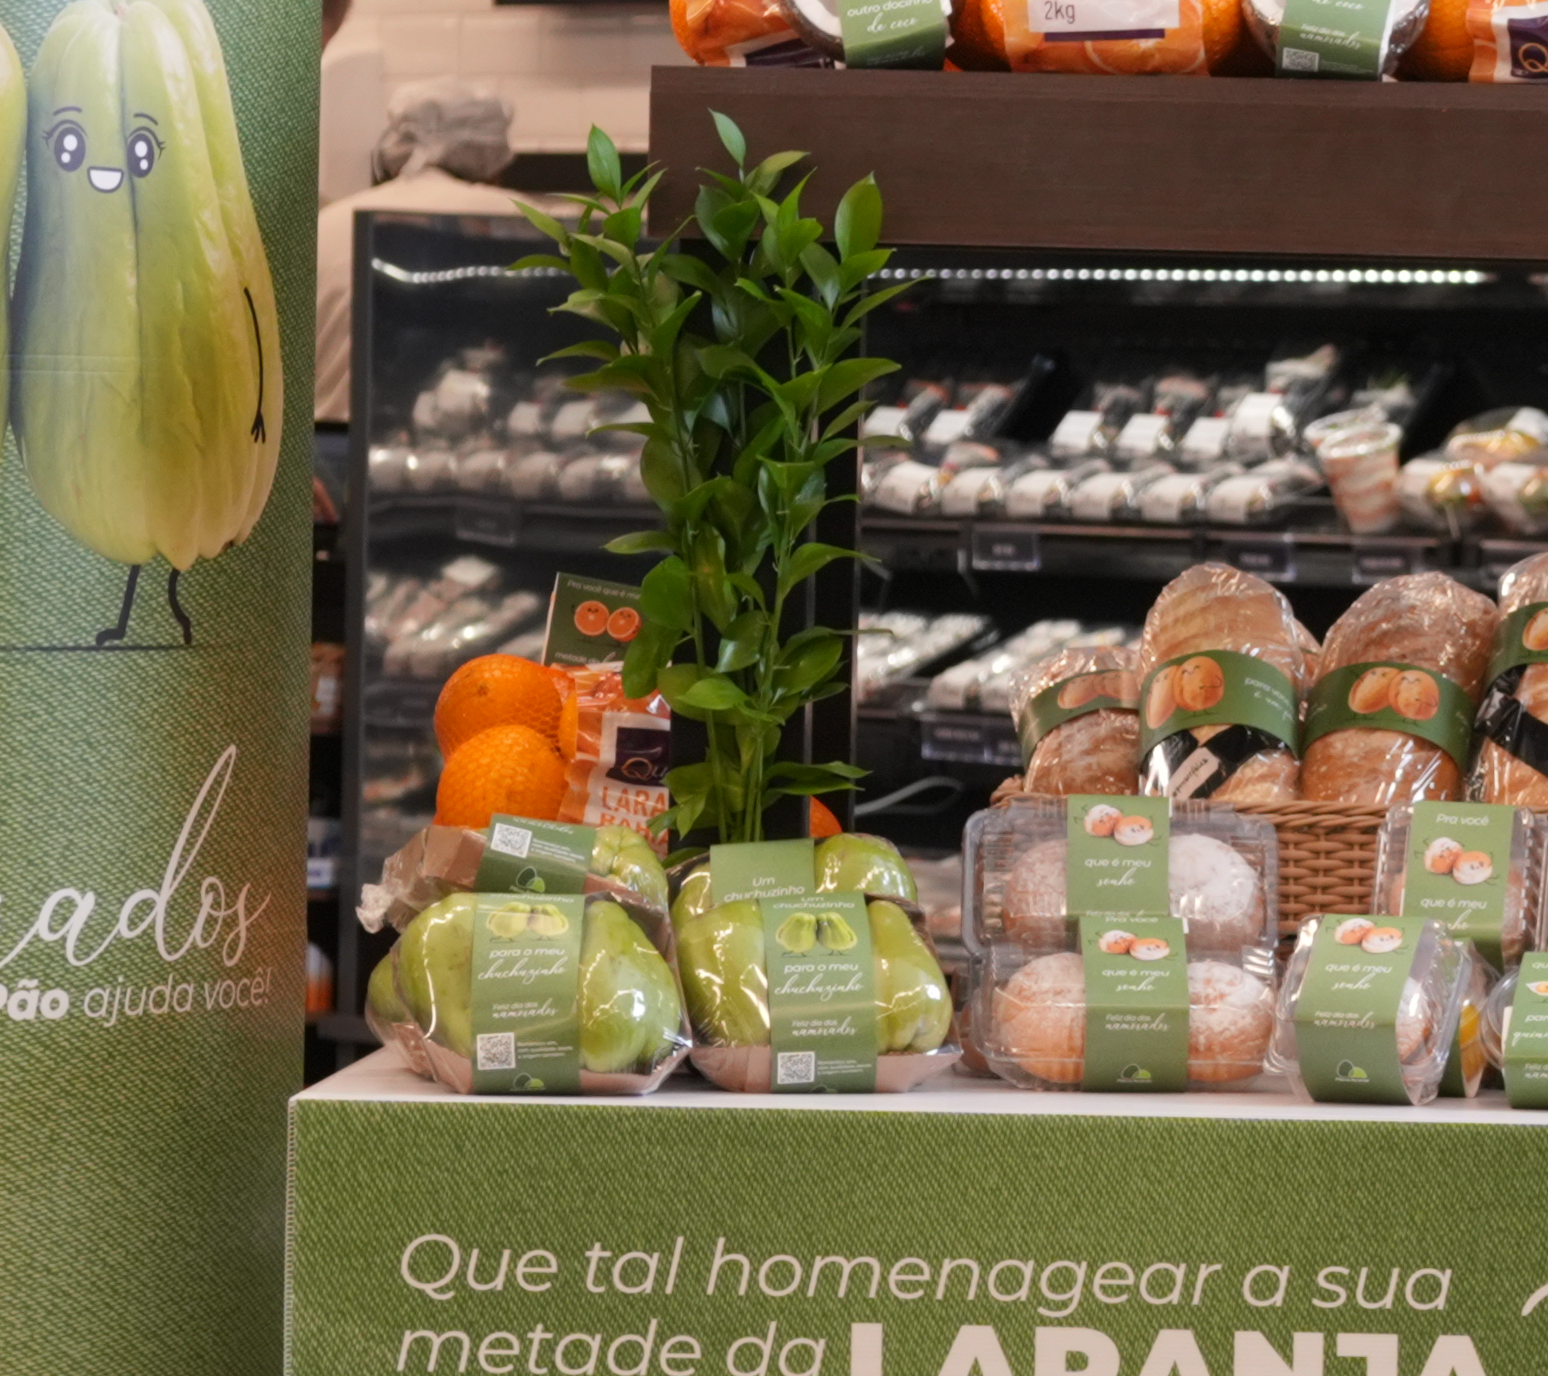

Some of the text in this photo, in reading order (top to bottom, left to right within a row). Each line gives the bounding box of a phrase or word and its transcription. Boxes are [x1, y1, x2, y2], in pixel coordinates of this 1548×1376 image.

[847, 5, 880, 17] outro
[1044, 1, 1076, 24] 2kg
[83, 976, 195, 1027] ajuda
[204, 969, 271, 1008] você!
[398, 1232, 1453, 1318] Que tal homenagear a sua
